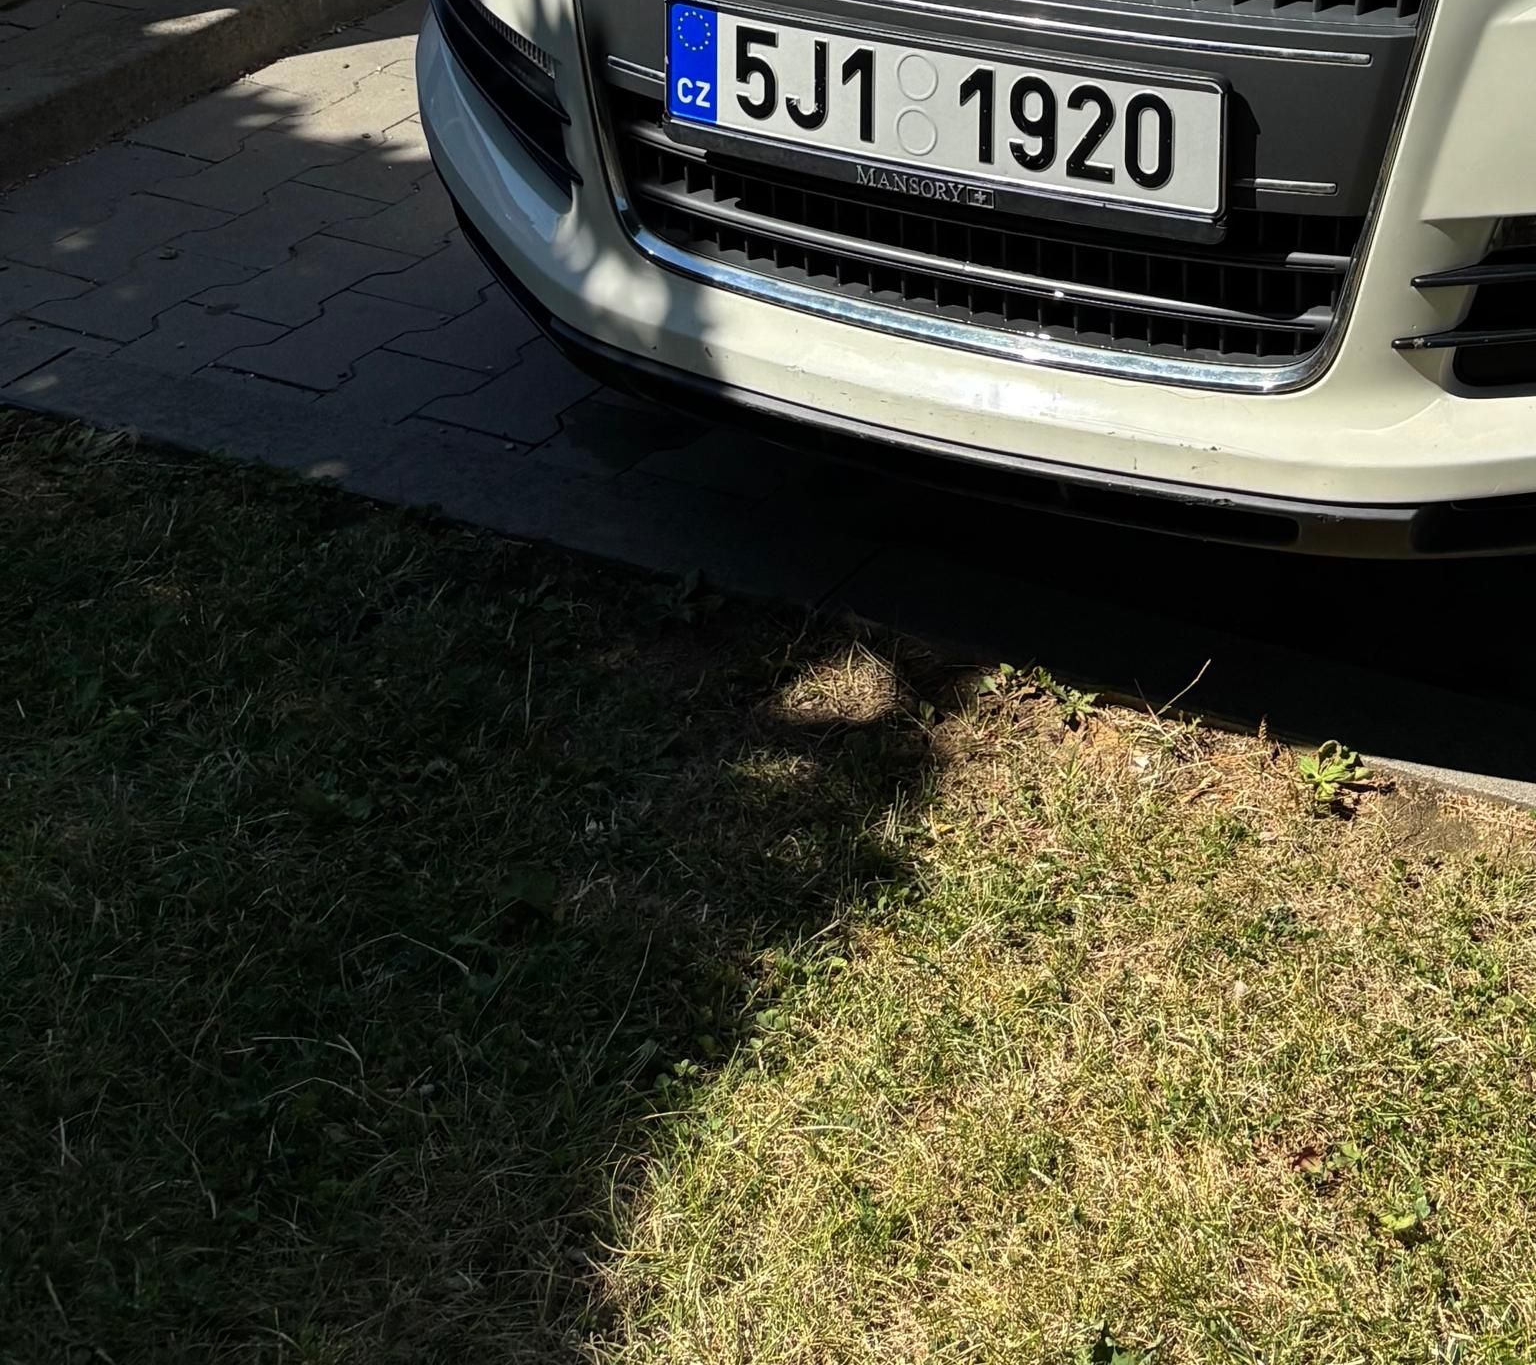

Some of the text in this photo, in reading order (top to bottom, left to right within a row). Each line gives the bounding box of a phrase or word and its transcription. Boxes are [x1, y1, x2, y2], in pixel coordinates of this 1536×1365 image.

[676, 77, 711, 109] CZ
[735, 24, 1175, 190] 5J1 1920
